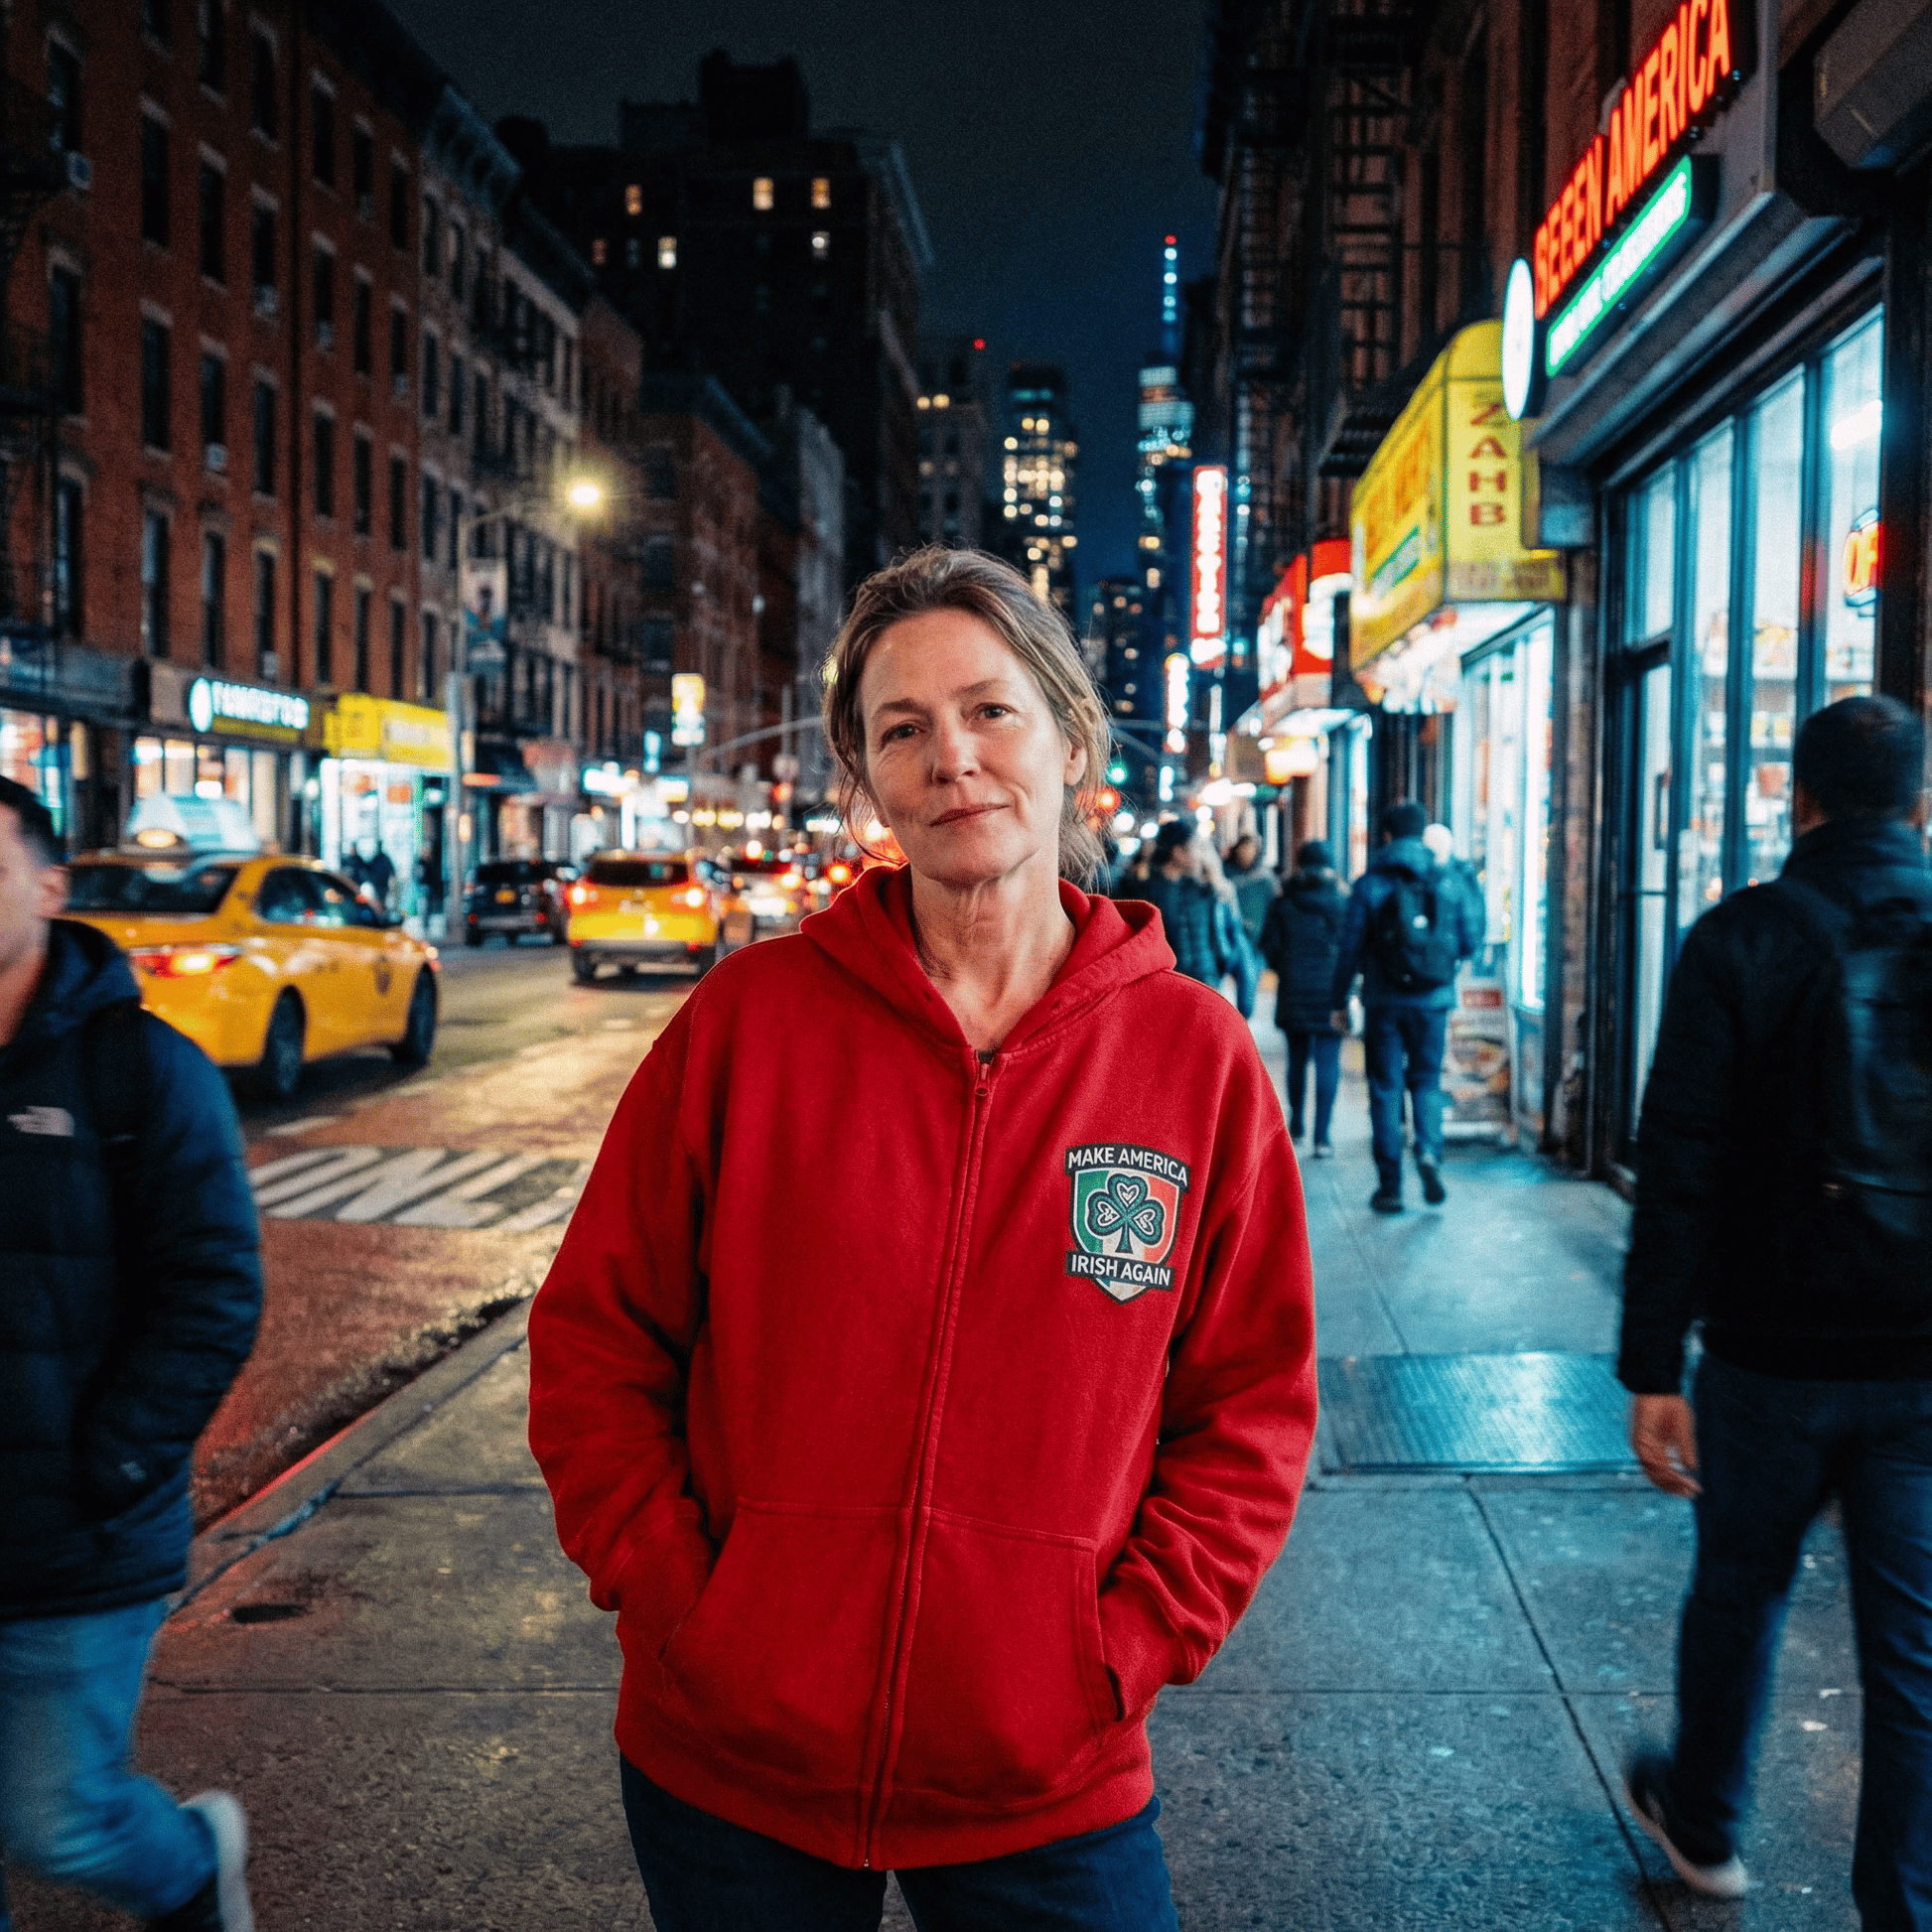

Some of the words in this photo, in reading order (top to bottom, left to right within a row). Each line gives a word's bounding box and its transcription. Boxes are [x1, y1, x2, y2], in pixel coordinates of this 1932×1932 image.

[1604, 0, 1730, 227] AMERICA
[1067, 1147, 1116, 1170] MAKE
[1117, 1148, 1188, 1187] AMERICA
[1070, 1254, 1118, 1278] IRISH
[1119, 1262, 1172, 1287] AGAIN
